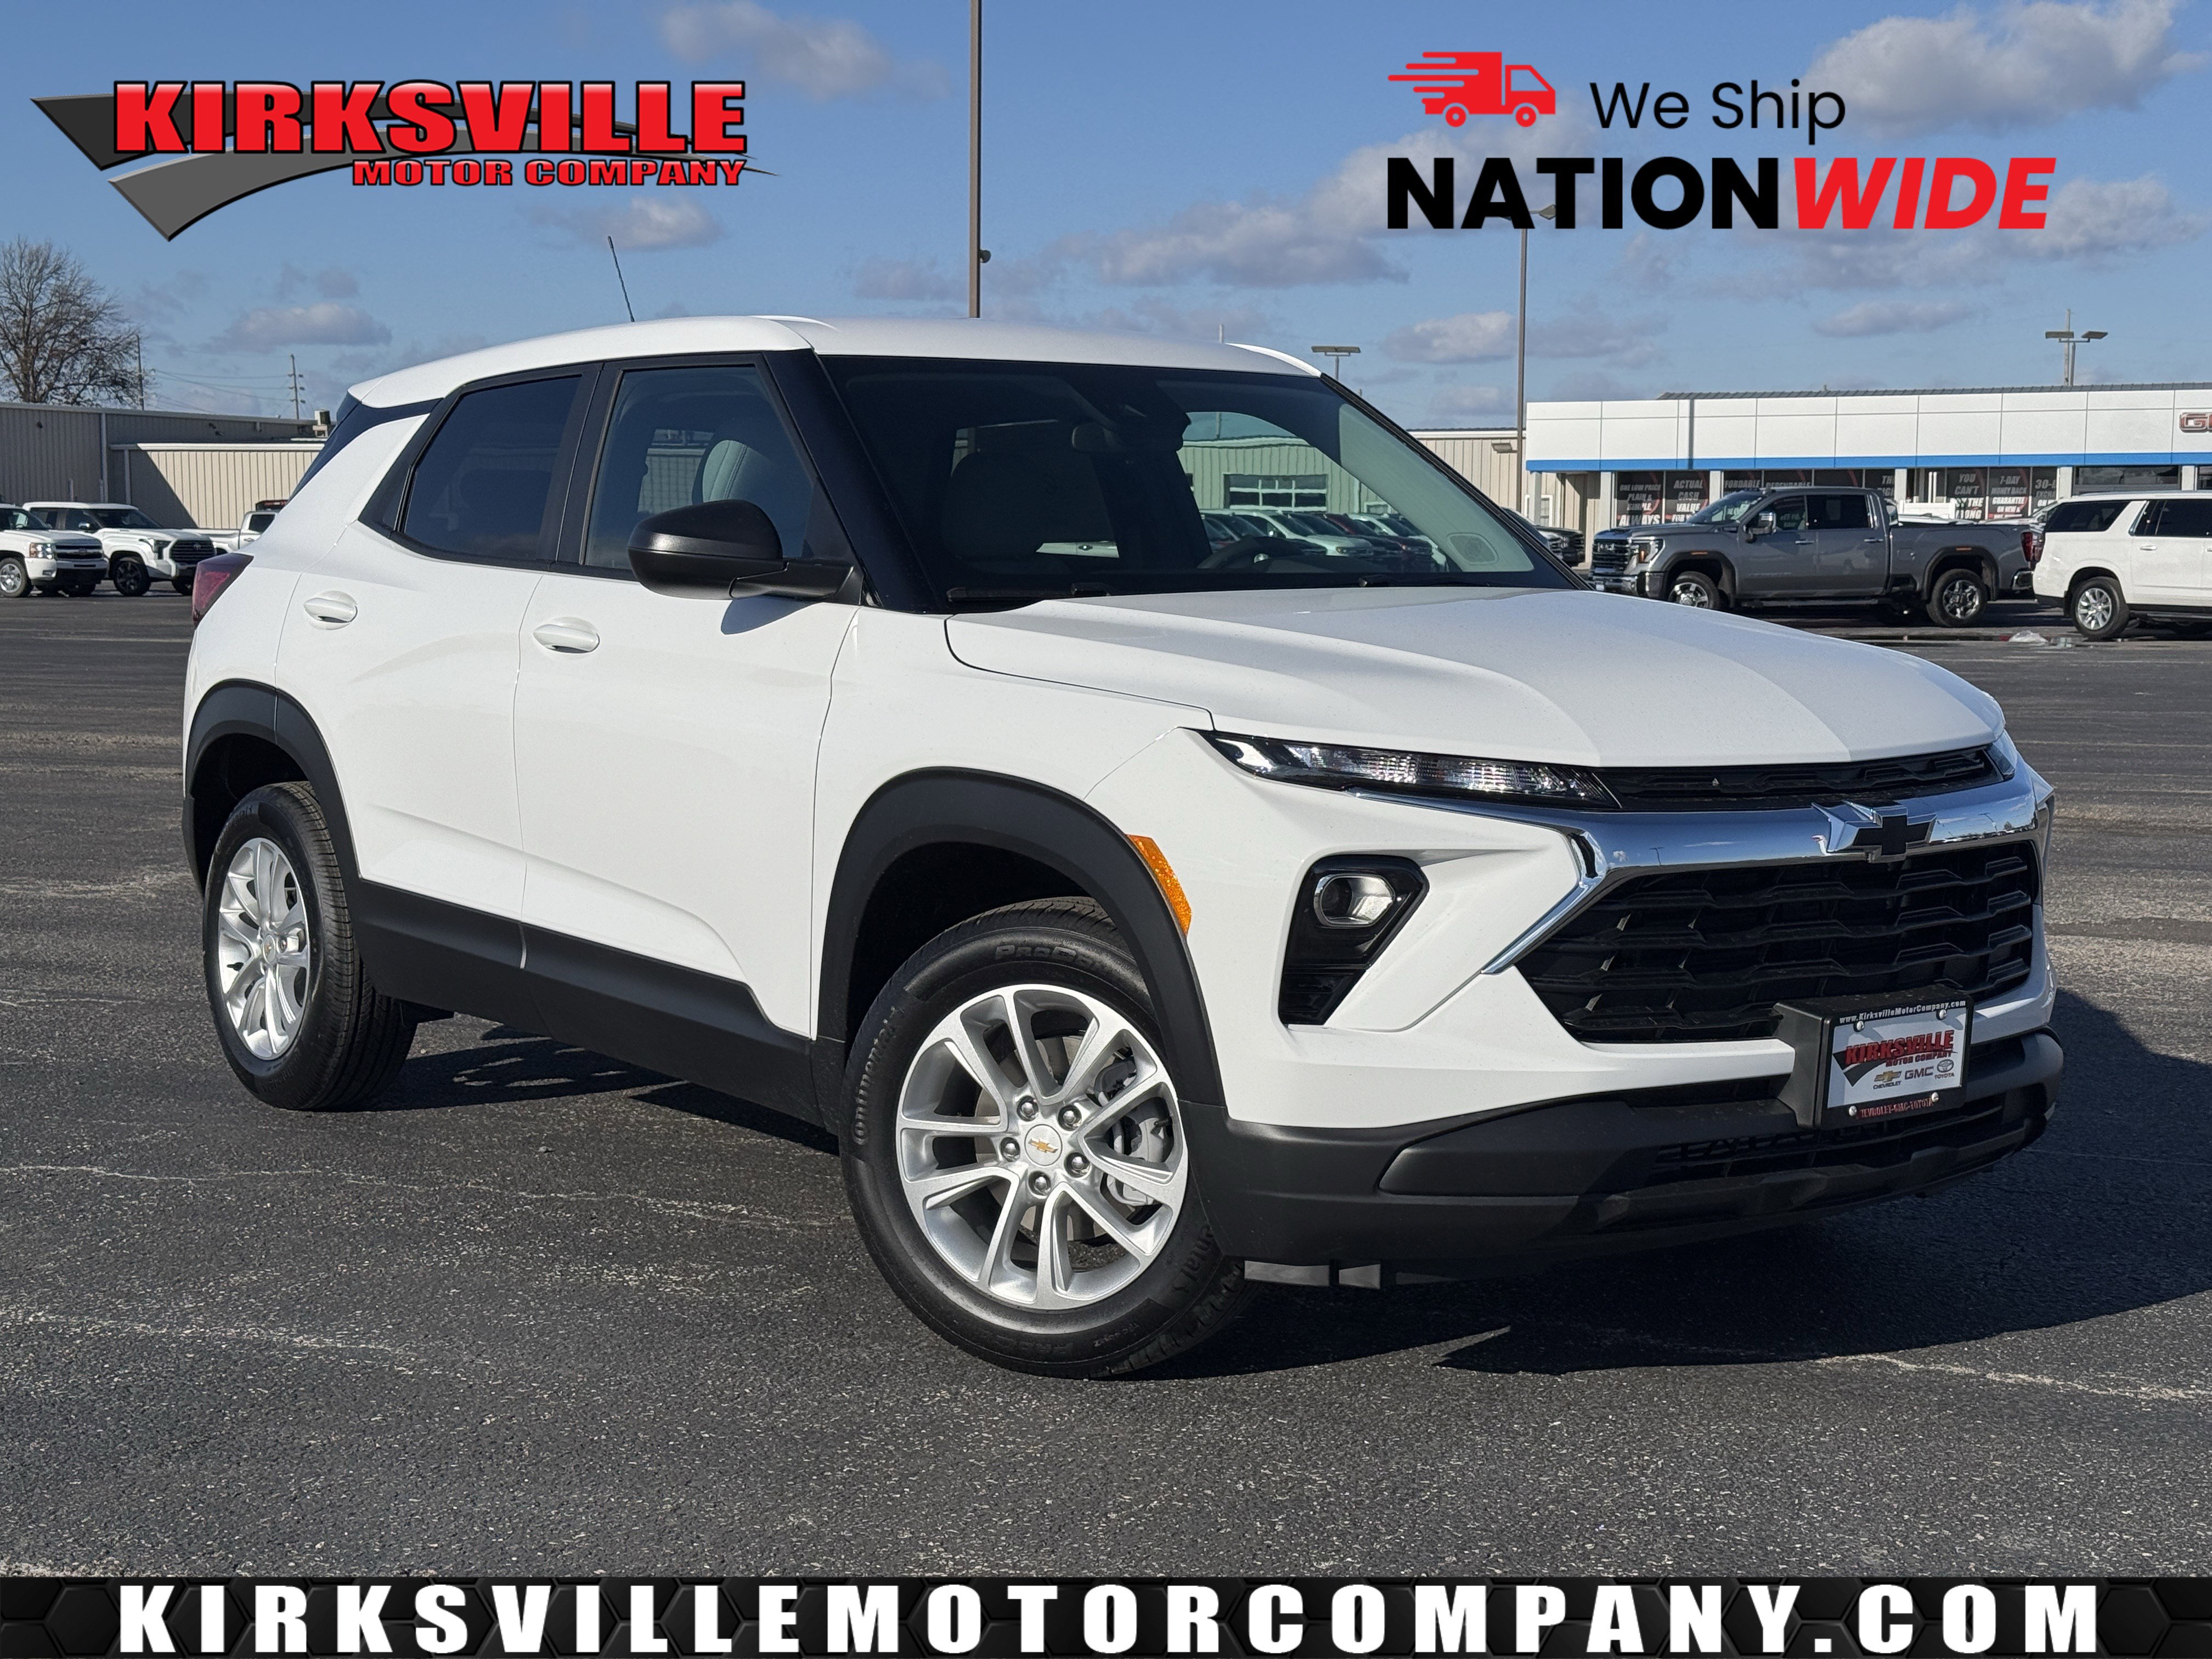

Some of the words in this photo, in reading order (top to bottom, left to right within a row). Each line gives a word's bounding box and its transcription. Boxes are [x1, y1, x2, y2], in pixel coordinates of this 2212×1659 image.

[1959, 473, 1976, 483] YOU
[1673, 479, 1703, 489] ACTUAL
[1724, 479, 1760, 488] FORDABLE
[1968, 497, 1984, 507] THE
[1619, 514, 1661, 526] ALWAYS
[1845, 1030, 1955, 1065] KIRKSVILLE
[1915, 1049, 1953, 1062] COMPANY
[1905, 1066, 1934, 1080] GMC
[1873, 1080, 1902, 1090] CHEVROLET
